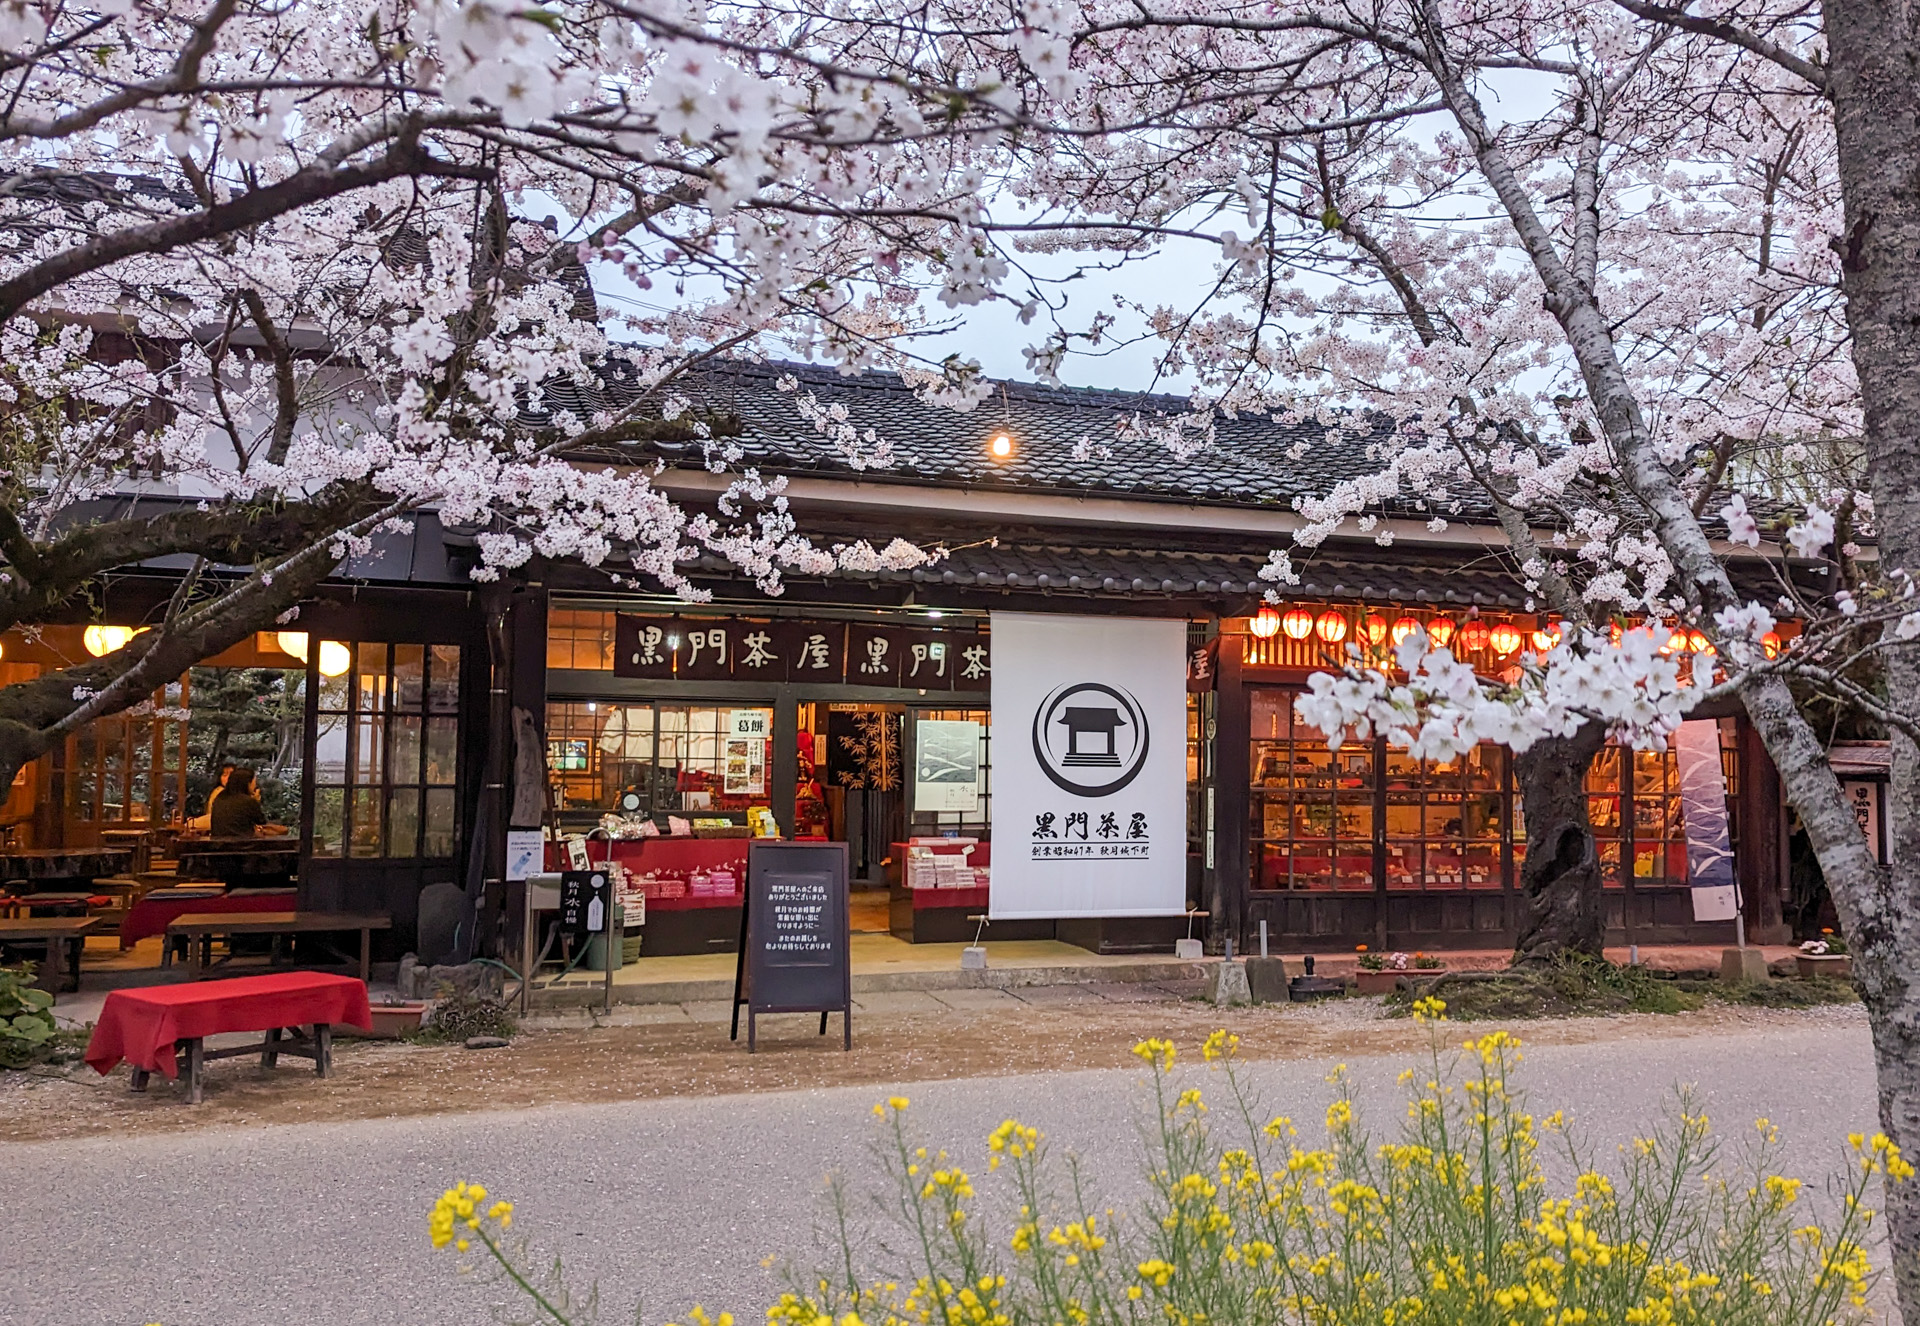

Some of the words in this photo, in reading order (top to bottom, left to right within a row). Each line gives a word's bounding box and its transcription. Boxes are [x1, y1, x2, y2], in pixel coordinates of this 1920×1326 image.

[632, 626, 831, 670] 黒門茶屋
[860, 637, 991, 680] 黒門茶
[1032, 811, 1150, 841] 黒門茶屋
[768, 893, 828, 901] ありがとうございました
